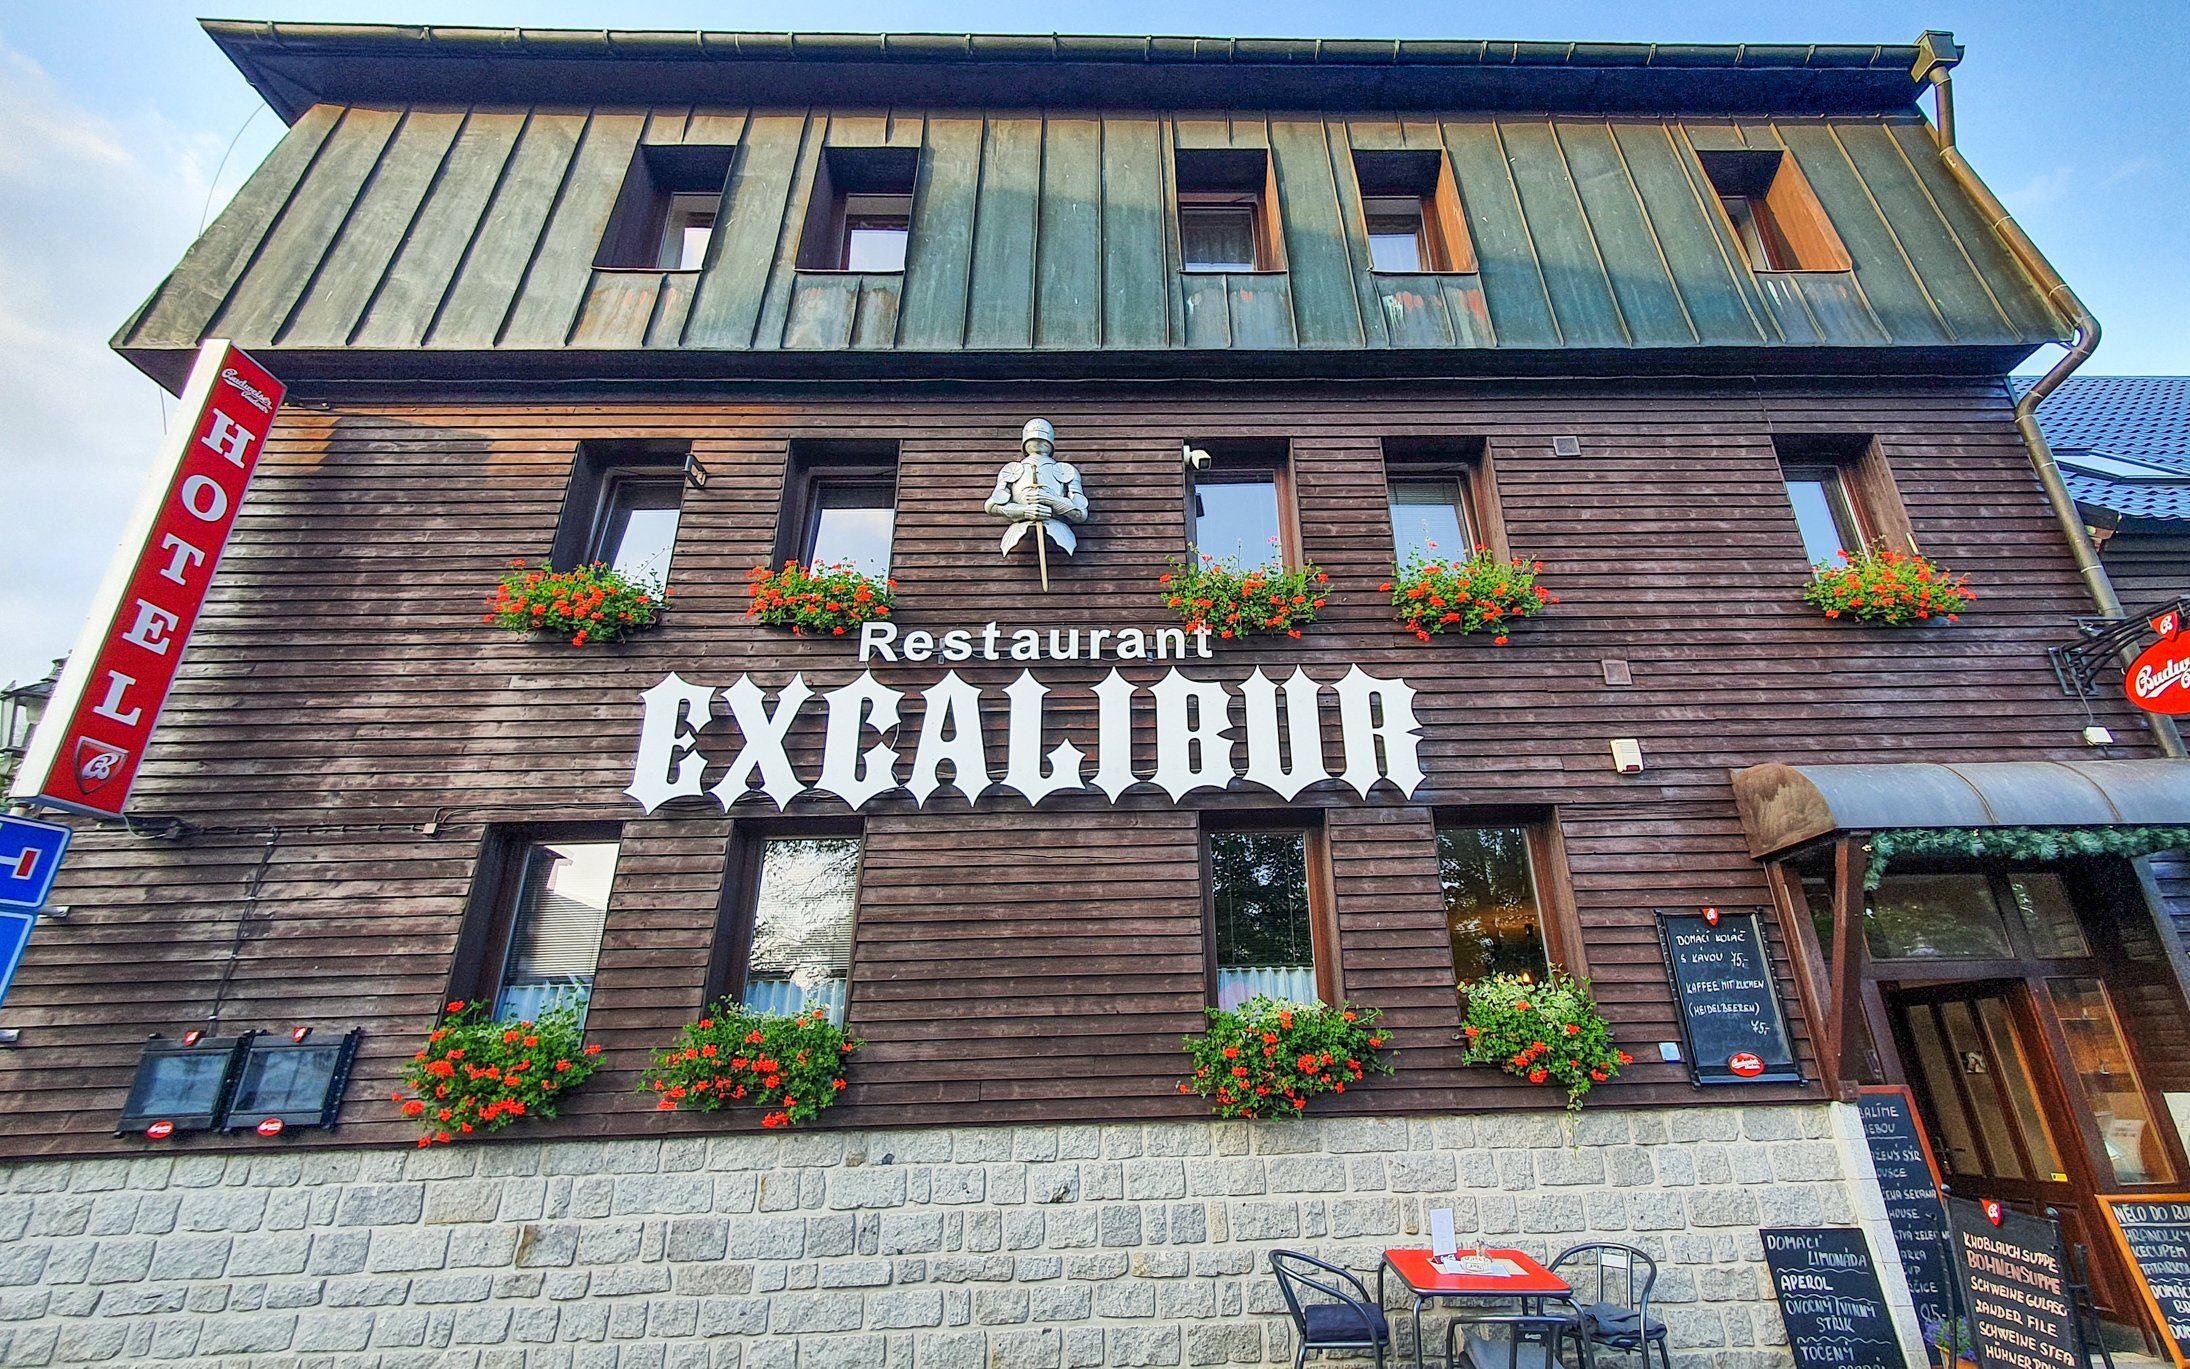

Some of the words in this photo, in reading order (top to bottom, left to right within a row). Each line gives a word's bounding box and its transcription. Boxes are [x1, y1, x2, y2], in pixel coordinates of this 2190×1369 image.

[93, 407, 256, 727] HOTEL
[859, 619, 1213, 662] Restaurant
[623, 664, 1427, 814] EXCALIBUR
[1686, 980, 1720, 994] KAFFEE
[2149, 1205, 2168, 1221] DO
[1780, 1274, 1834, 1291] APEROL
[1970, 1275, 2025, 1304] SCHWEINE
[1979, 1320, 2037, 1352] SCHWEINE
[2026, 1314, 2059, 1338] FILE
